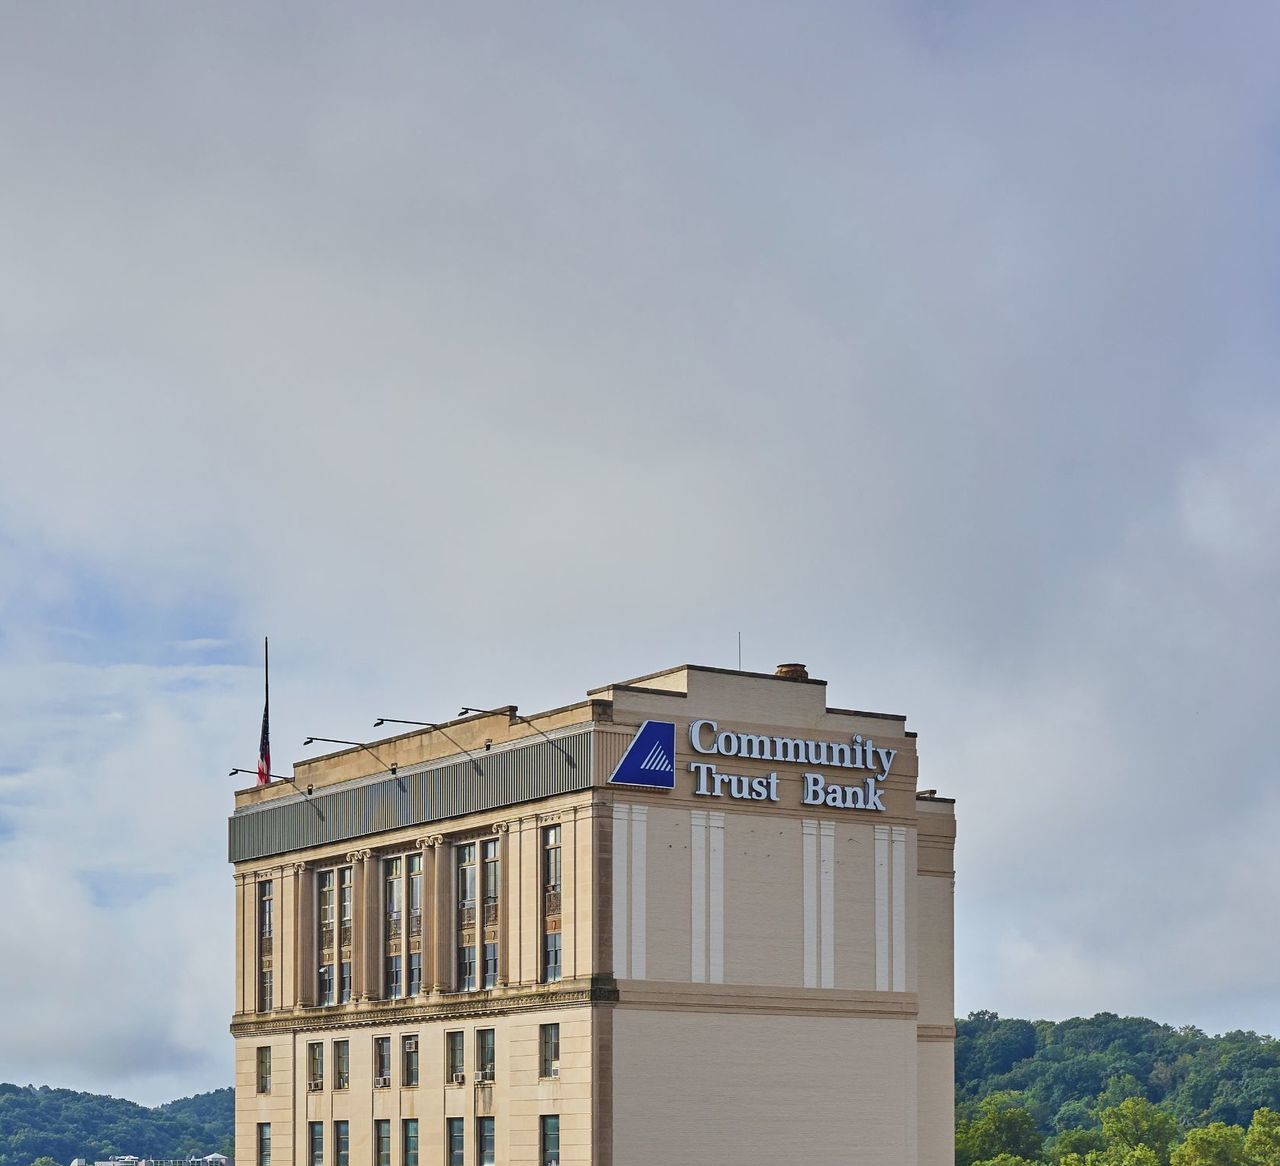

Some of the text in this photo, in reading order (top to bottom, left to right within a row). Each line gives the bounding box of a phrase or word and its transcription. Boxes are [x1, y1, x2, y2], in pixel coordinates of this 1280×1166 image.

[688, 719, 897, 781] Community
[688, 761, 886, 811] Trust Bank
